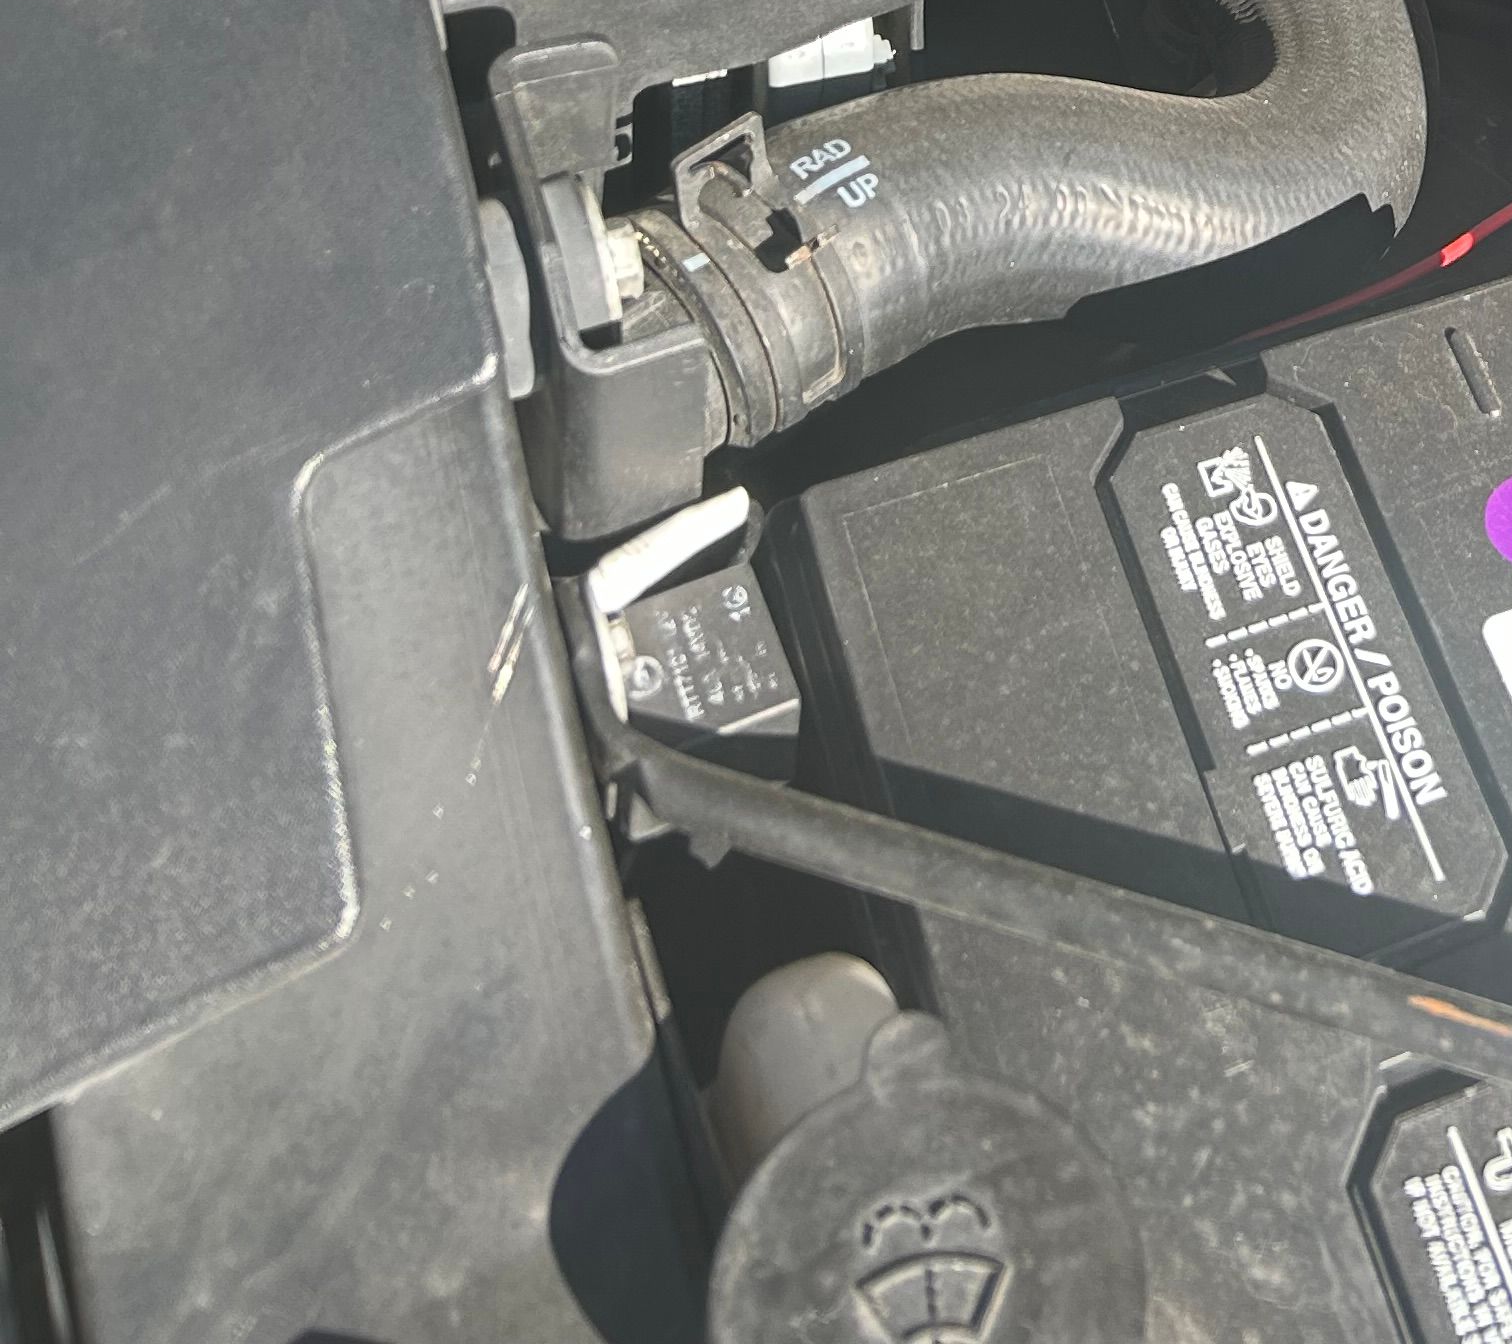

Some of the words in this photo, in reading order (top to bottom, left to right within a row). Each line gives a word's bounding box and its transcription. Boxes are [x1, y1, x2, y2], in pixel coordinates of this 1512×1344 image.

[789, 138, 851, 180] RAD
[836, 173, 880, 209] UP
[1196, 517, 1230, 575] GASES
[1208, 510, 1263, 601] EXPLOSIVE
[1246, 542, 1276, 588] EYES
[1260, 536, 1301, 596] SHIELD
[1269, 660, 1292, 689] NO
[1293, 509, 1376, 644] DANGER
[1368, 671, 1447, 805] POISON
[1299, 755, 1356, 849] SULFURIC
[1339, 850, 1373, 894] ACID
